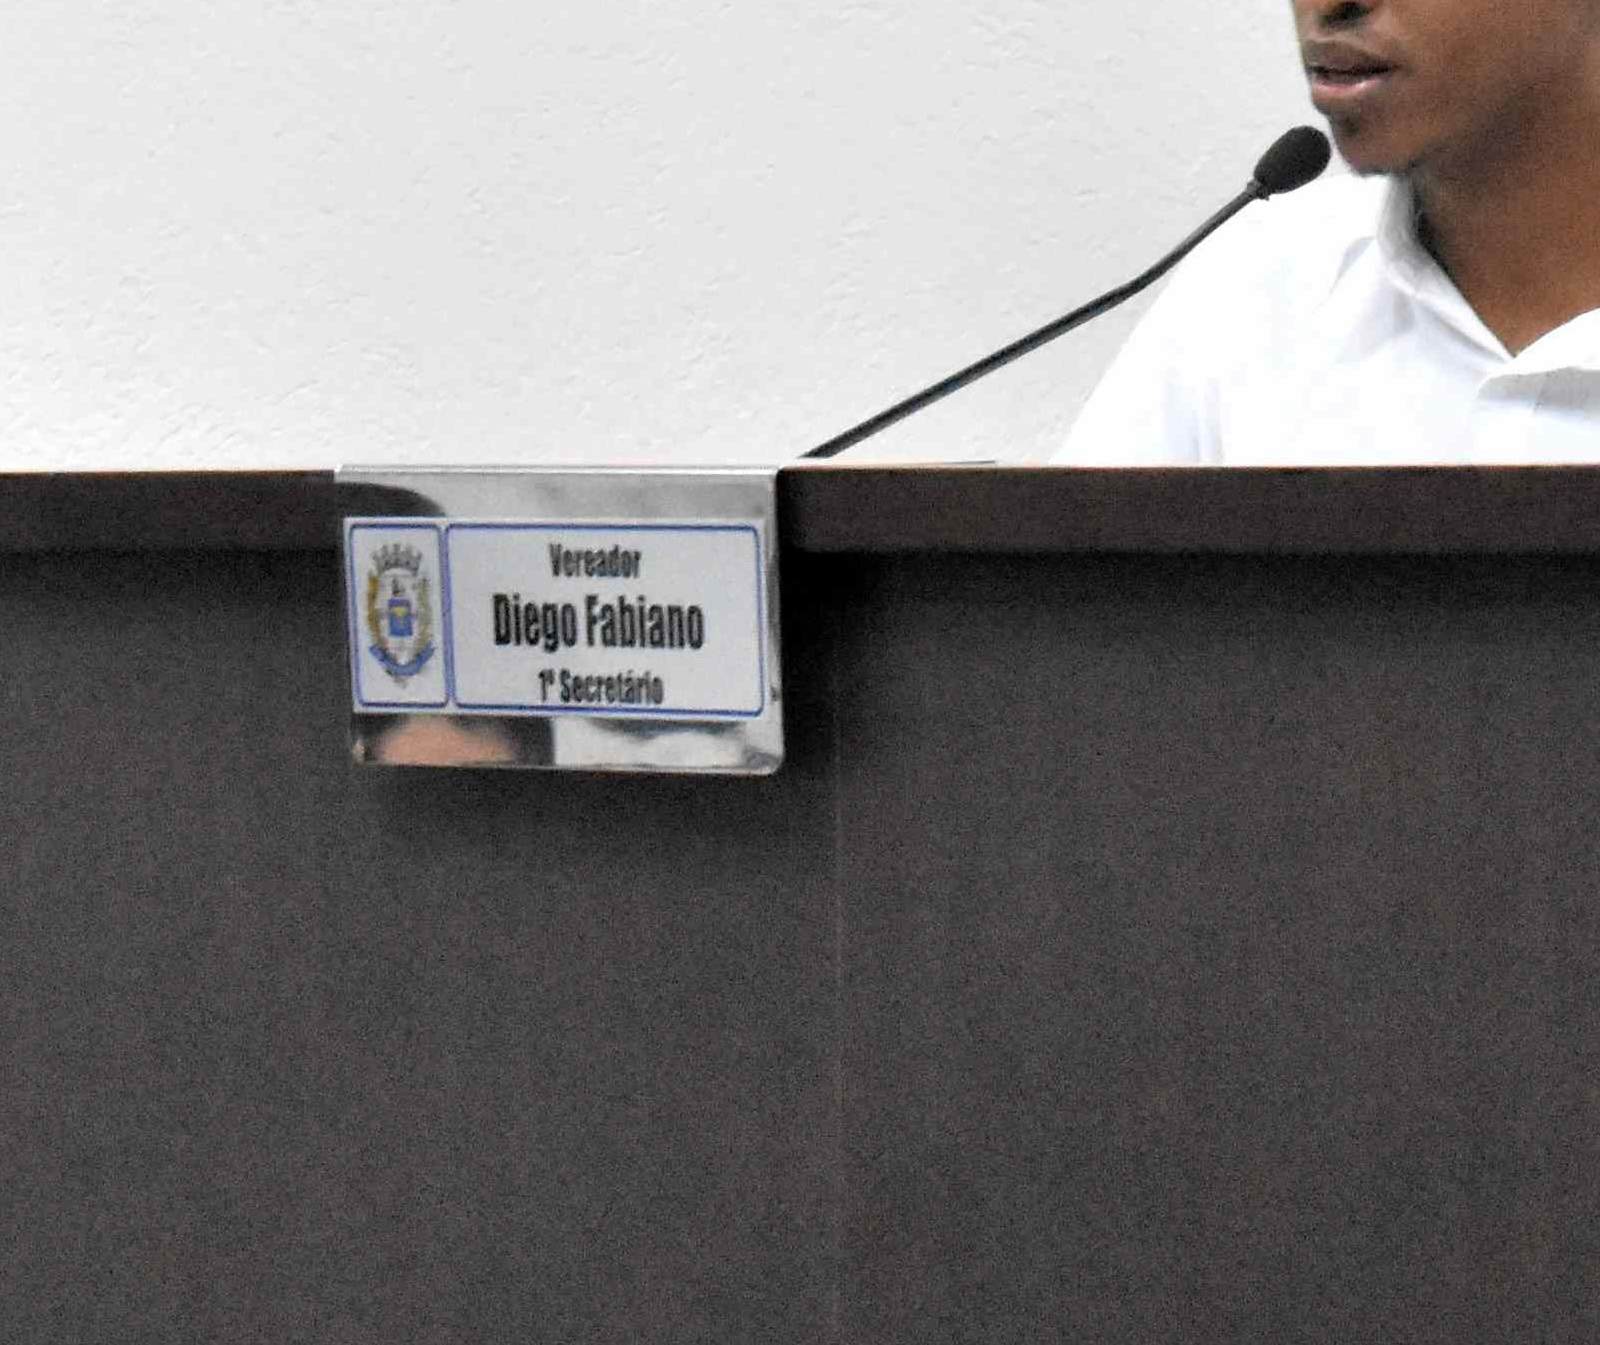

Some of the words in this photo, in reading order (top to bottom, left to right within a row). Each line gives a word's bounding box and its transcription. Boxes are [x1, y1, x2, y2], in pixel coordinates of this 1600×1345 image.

[549, 543, 641, 578] Vereador
[492, 593, 578, 653] Diego
[585, 594, 704, 650] Fabiano
[559, 668, 664, 705] Secretário
